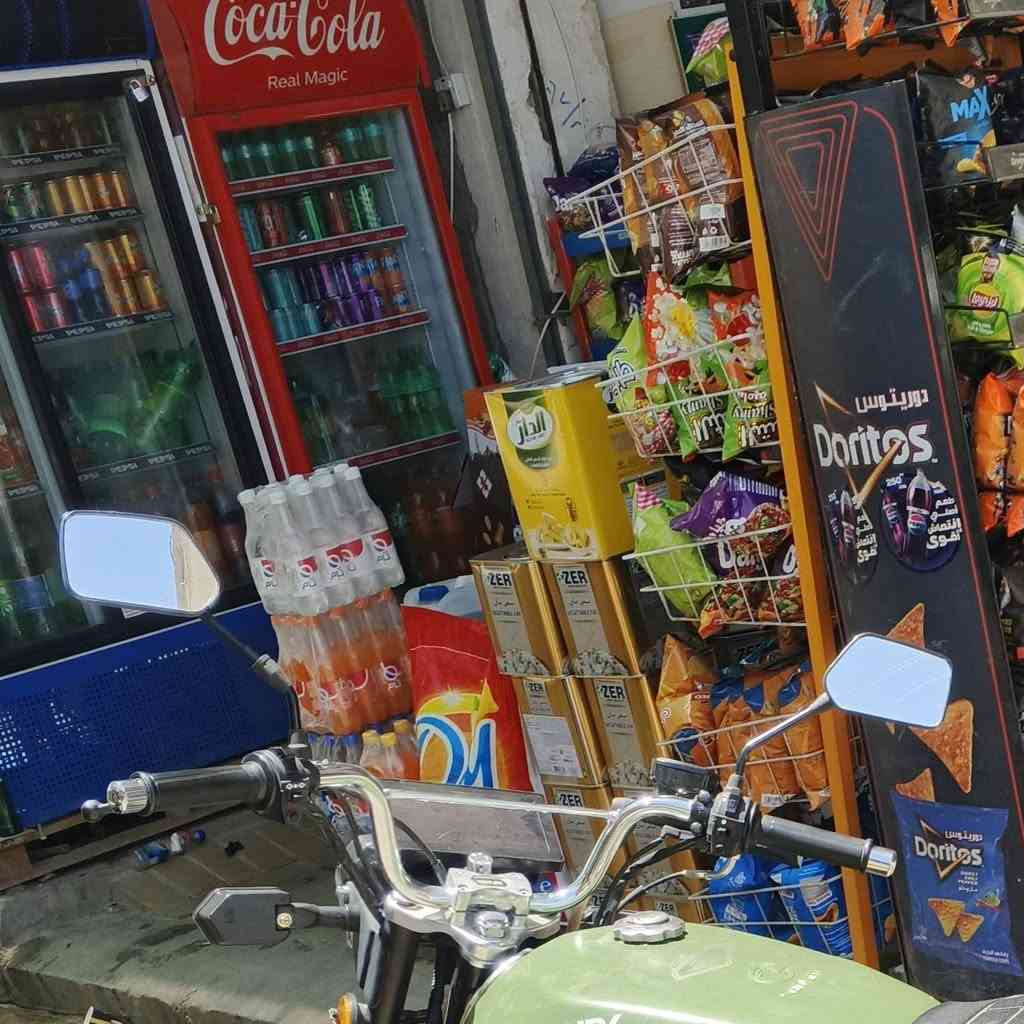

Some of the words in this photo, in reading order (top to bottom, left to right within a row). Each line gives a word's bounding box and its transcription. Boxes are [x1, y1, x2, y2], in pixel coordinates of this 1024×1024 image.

[204, 0, 385, 66] Coca-Cola
[268, 73, 301, 89] Real
[305, 66, 349, 86] Magic
[950, 85, 992, 122] MAX
[854, 387, 929, 414] دوريتوس
[812, 422, 934, 469] Doritos
[489, 572, 512, 587] ZER
[563, 569, 589, 586] ZER
[600, 684, 625, 700] ZER
[560, 792, 584, 808] ZER
[914, 835, 983, 866] Doritos
